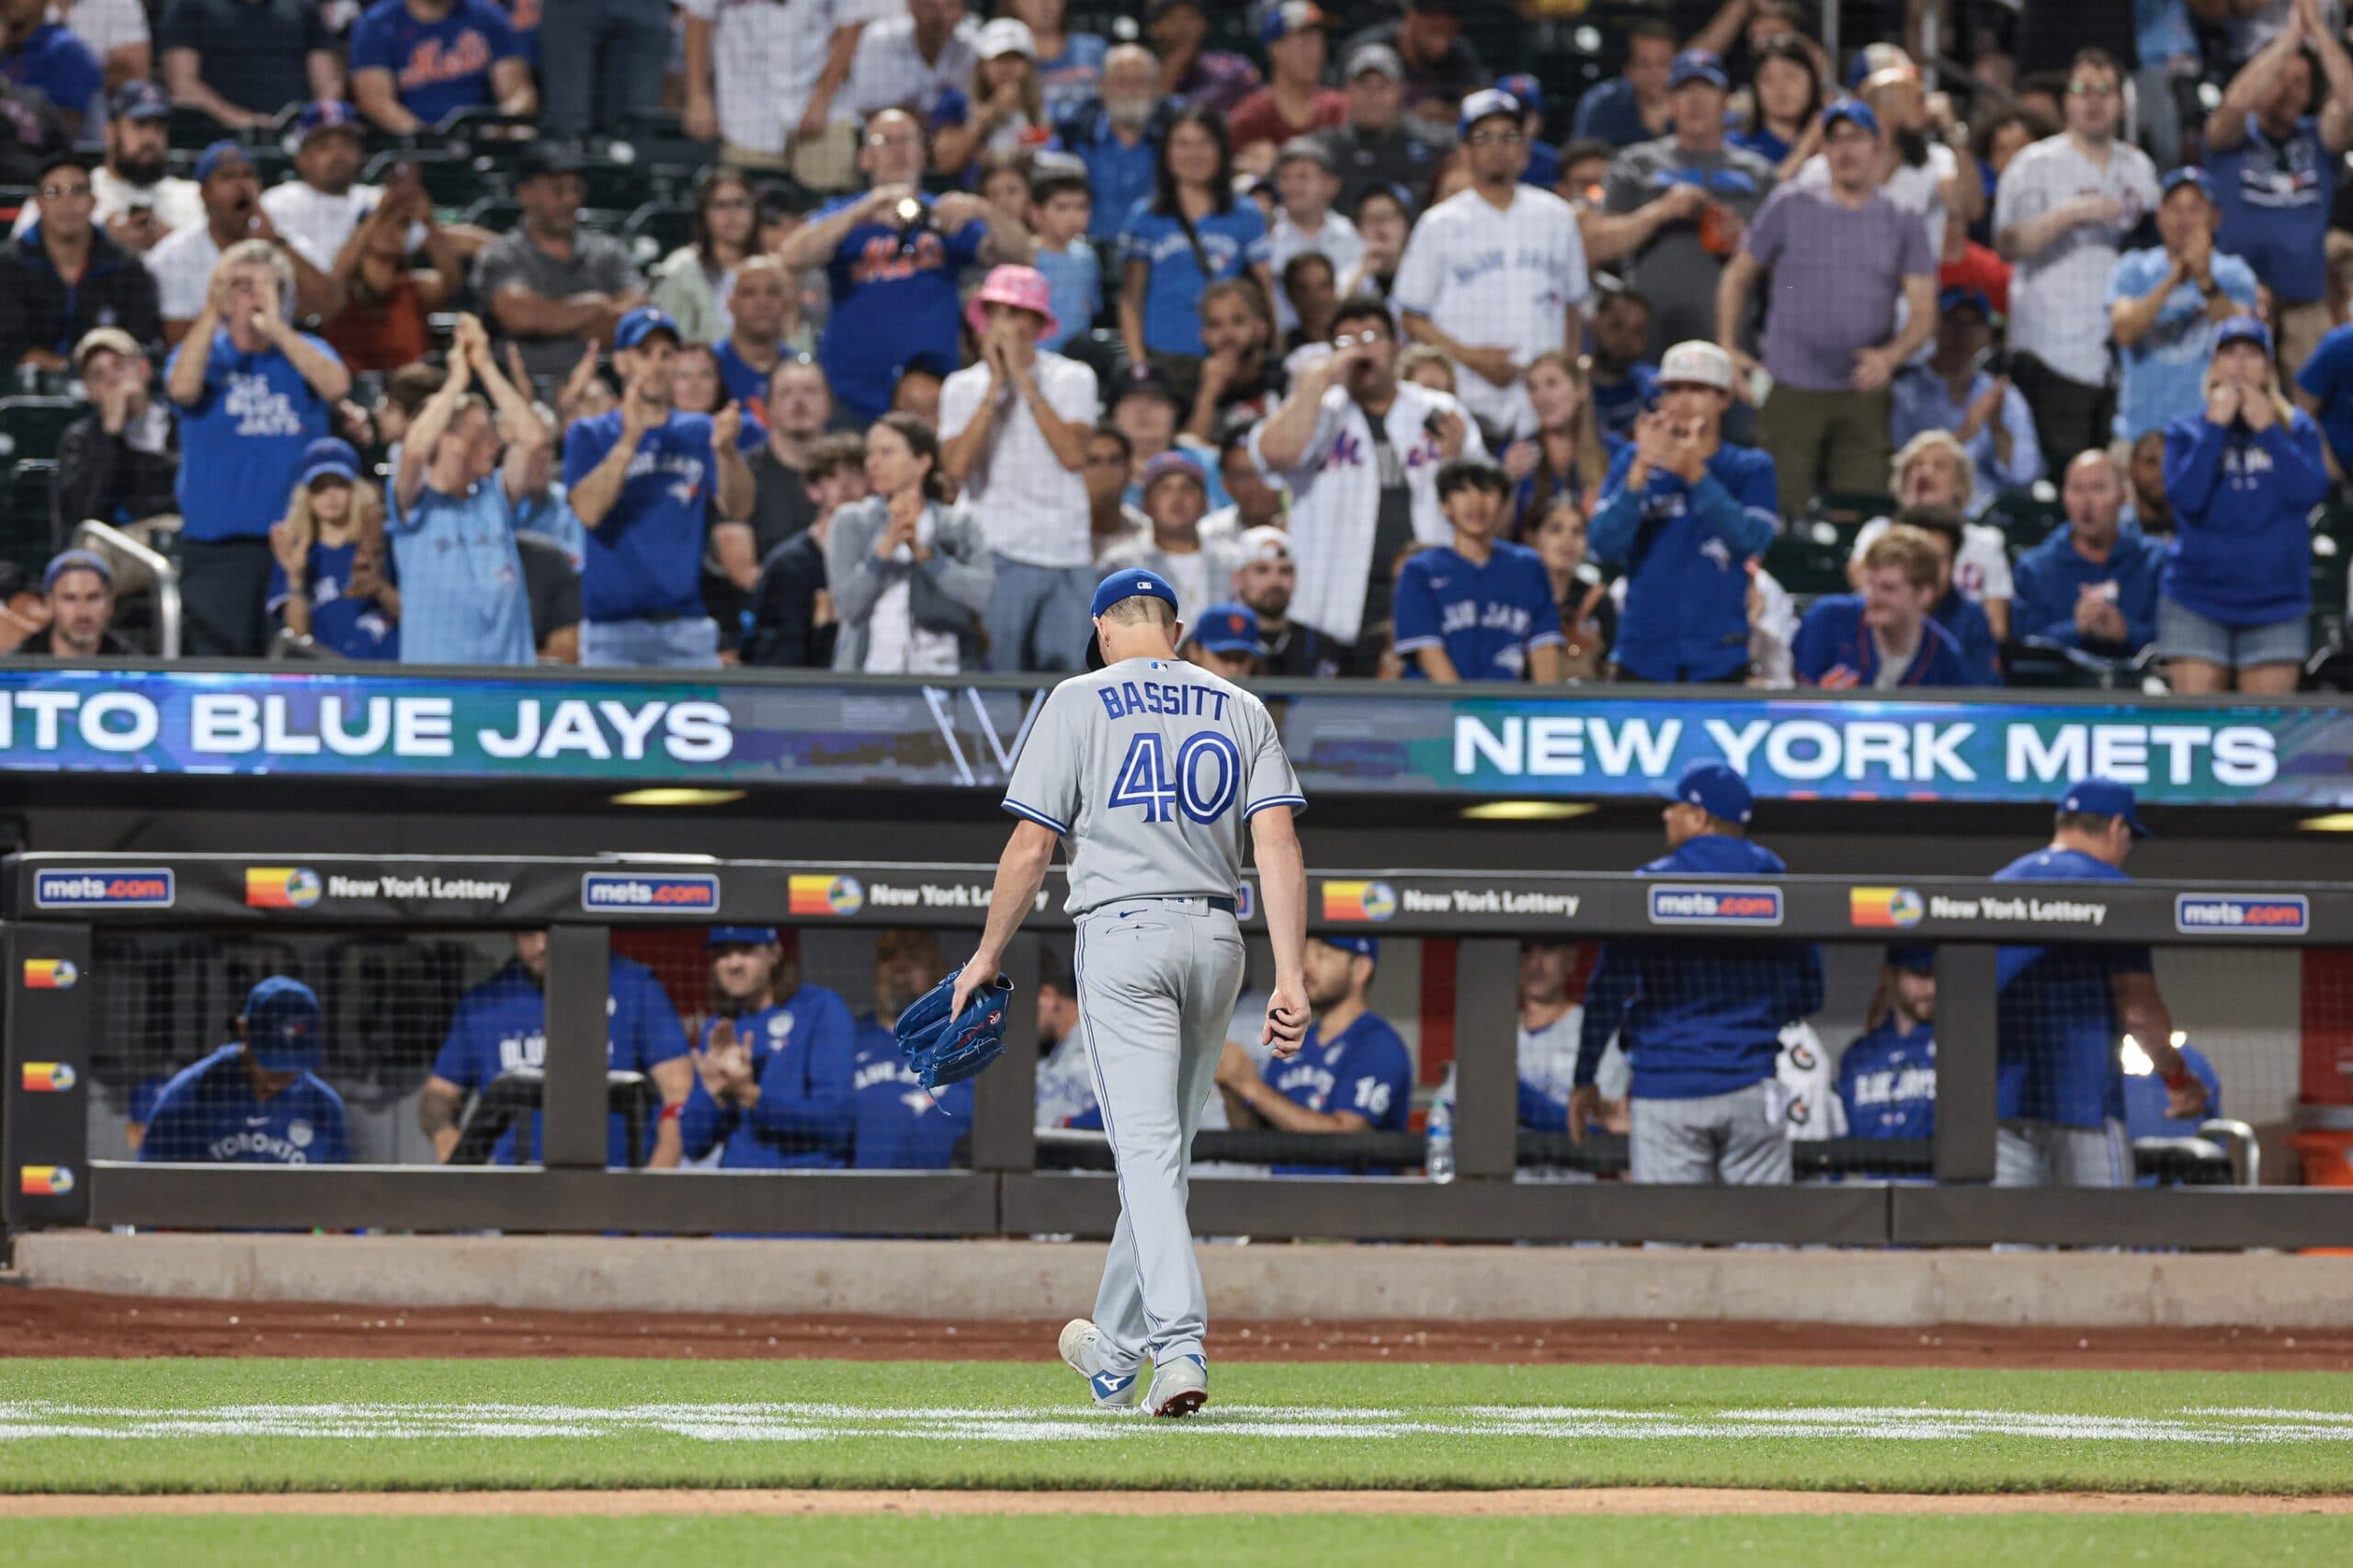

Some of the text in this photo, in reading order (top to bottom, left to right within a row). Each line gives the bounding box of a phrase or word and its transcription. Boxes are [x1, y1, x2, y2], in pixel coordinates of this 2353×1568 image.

[1097, 681, 1231, 721] BASSITT
[0, 690, 733, 762] TO BLUE JAYS
[1453, 716, 2279, 788] NEW YORK METS
[1108, 730, 1241, 825] 40
[42, 875, 166, 900] mets.com
[327, 875, 511, 903] New York Lottery
[589, 880, 711, 904] mets.com
[870, 883, 918, 906] New
[920, 884, 969, 907] York
[1403, 889, 1580, 918] New York Lottery
[1656, 892, 1775, 916] mets.com
[1930, 895, 2107, 926] New York Lottery
[2183, 902, 2302, 926] mets.com
[1353, 1075, 1392, 1116] 16
[209, 1131, 307, 1165] TORONTO
